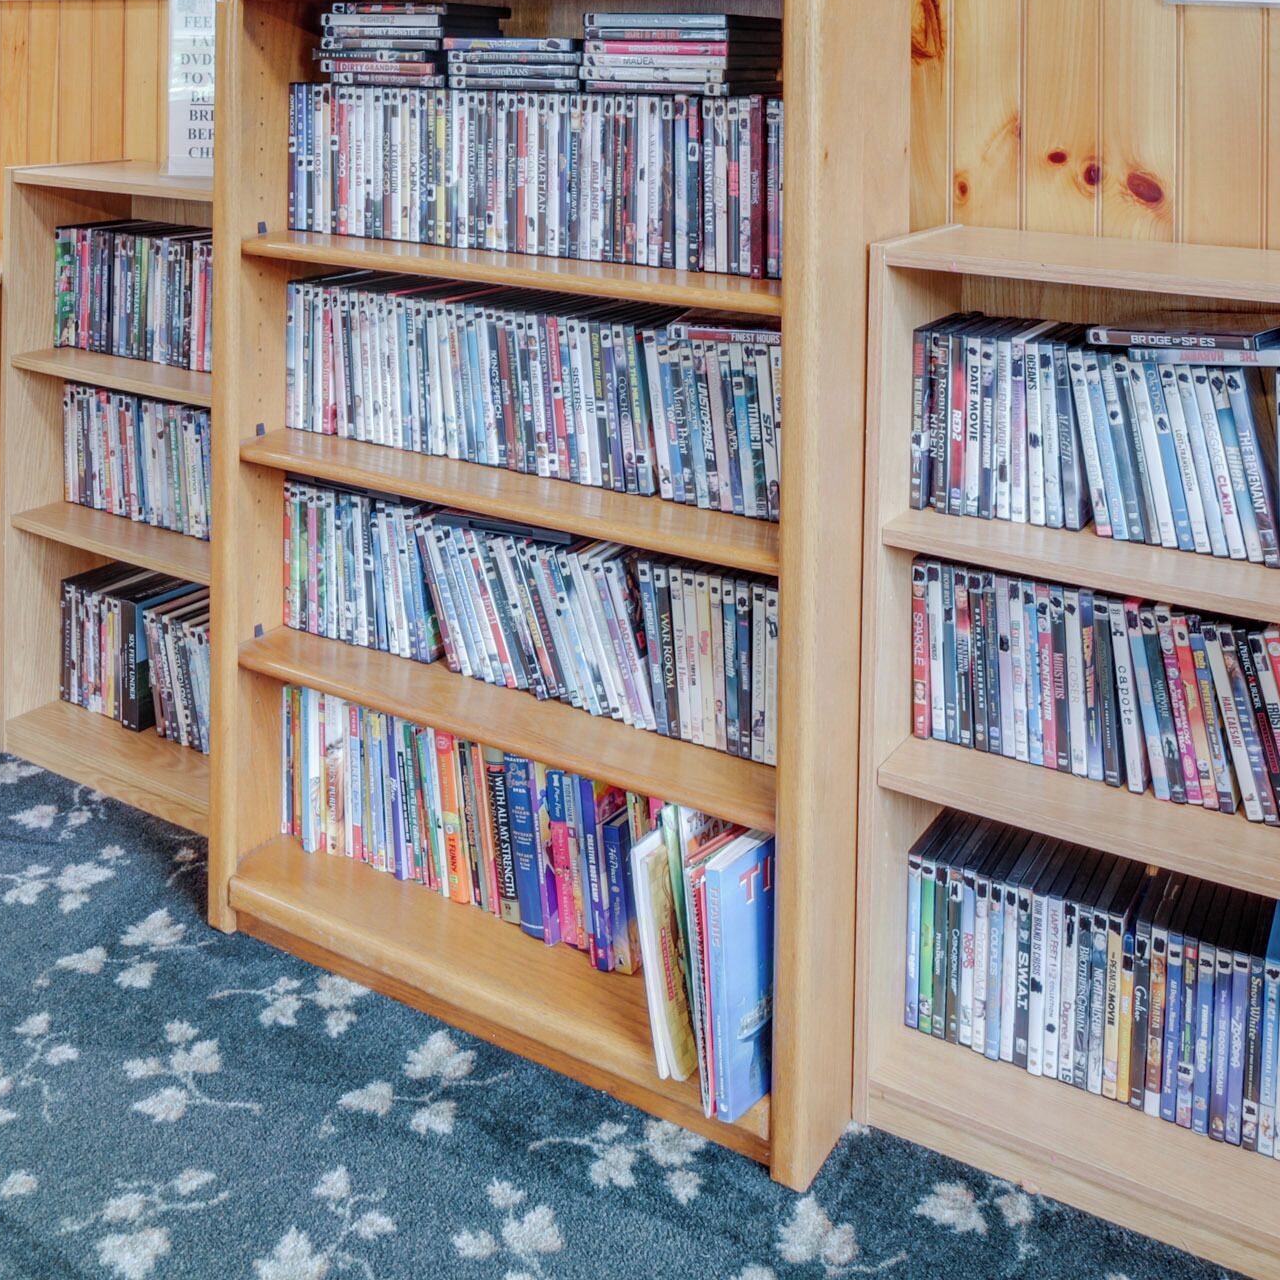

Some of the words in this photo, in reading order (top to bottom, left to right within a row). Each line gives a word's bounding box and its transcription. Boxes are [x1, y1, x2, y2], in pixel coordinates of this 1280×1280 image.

[184, 16, 212, 28] FEE
[342, 64, 363, 72] DIRTY
[364, 64, 400, 72] GRANDPA
[704, 139, 712, 191] CHASING
[767, 168, 775, 212] VAMPIRES
[705, 194, 713, 233] GRACE
[572, 367, 581, 411] SISTERS
[938, 378, 947, 421] ROBIN
[970, 365, 978, 395] DATE
[534, 399, 542, 428] SHORT
[606, 373, 616, 440] EVEREST
[698, 382, 714, 460] UNSTOPPABLE
[748, 403, 761, 442] TITANIC
[952, 409, 961, 430] RED
[969, 400, 978, 442] MOVIE
[762, 413, 773, 448] SPY
[938, 423, 946, 461] HOOD
[1058, 413, 1072, 464] MAGGIE
[1238, 430, 1251, 453] THE
[1217, 475, 1233, 515] CLAIM
[1242, 455, 1266, 514] REVENANT
[128, 633, 136, 648] SIX
[660, 612, 670, 642] WAR
[913, 612, 924, 666] SPARKLE
[663, 645, 674, 688] ROOM
[1117, 665, 1135, 726] capote
[494, 775, 507, 805] WITH
[497, 807, 508, 825] ALL
[499, 826, 510, 842] MY
[448, 843, 457, 873] FUNNY
[501, 844, 515, 897] STRENGTH
[1108, 959, 1117, 992] PEANUTS
[1061, 1001, 1071, 1040] Dupree
[1107, 993, 1116, 1026] MOVIE
